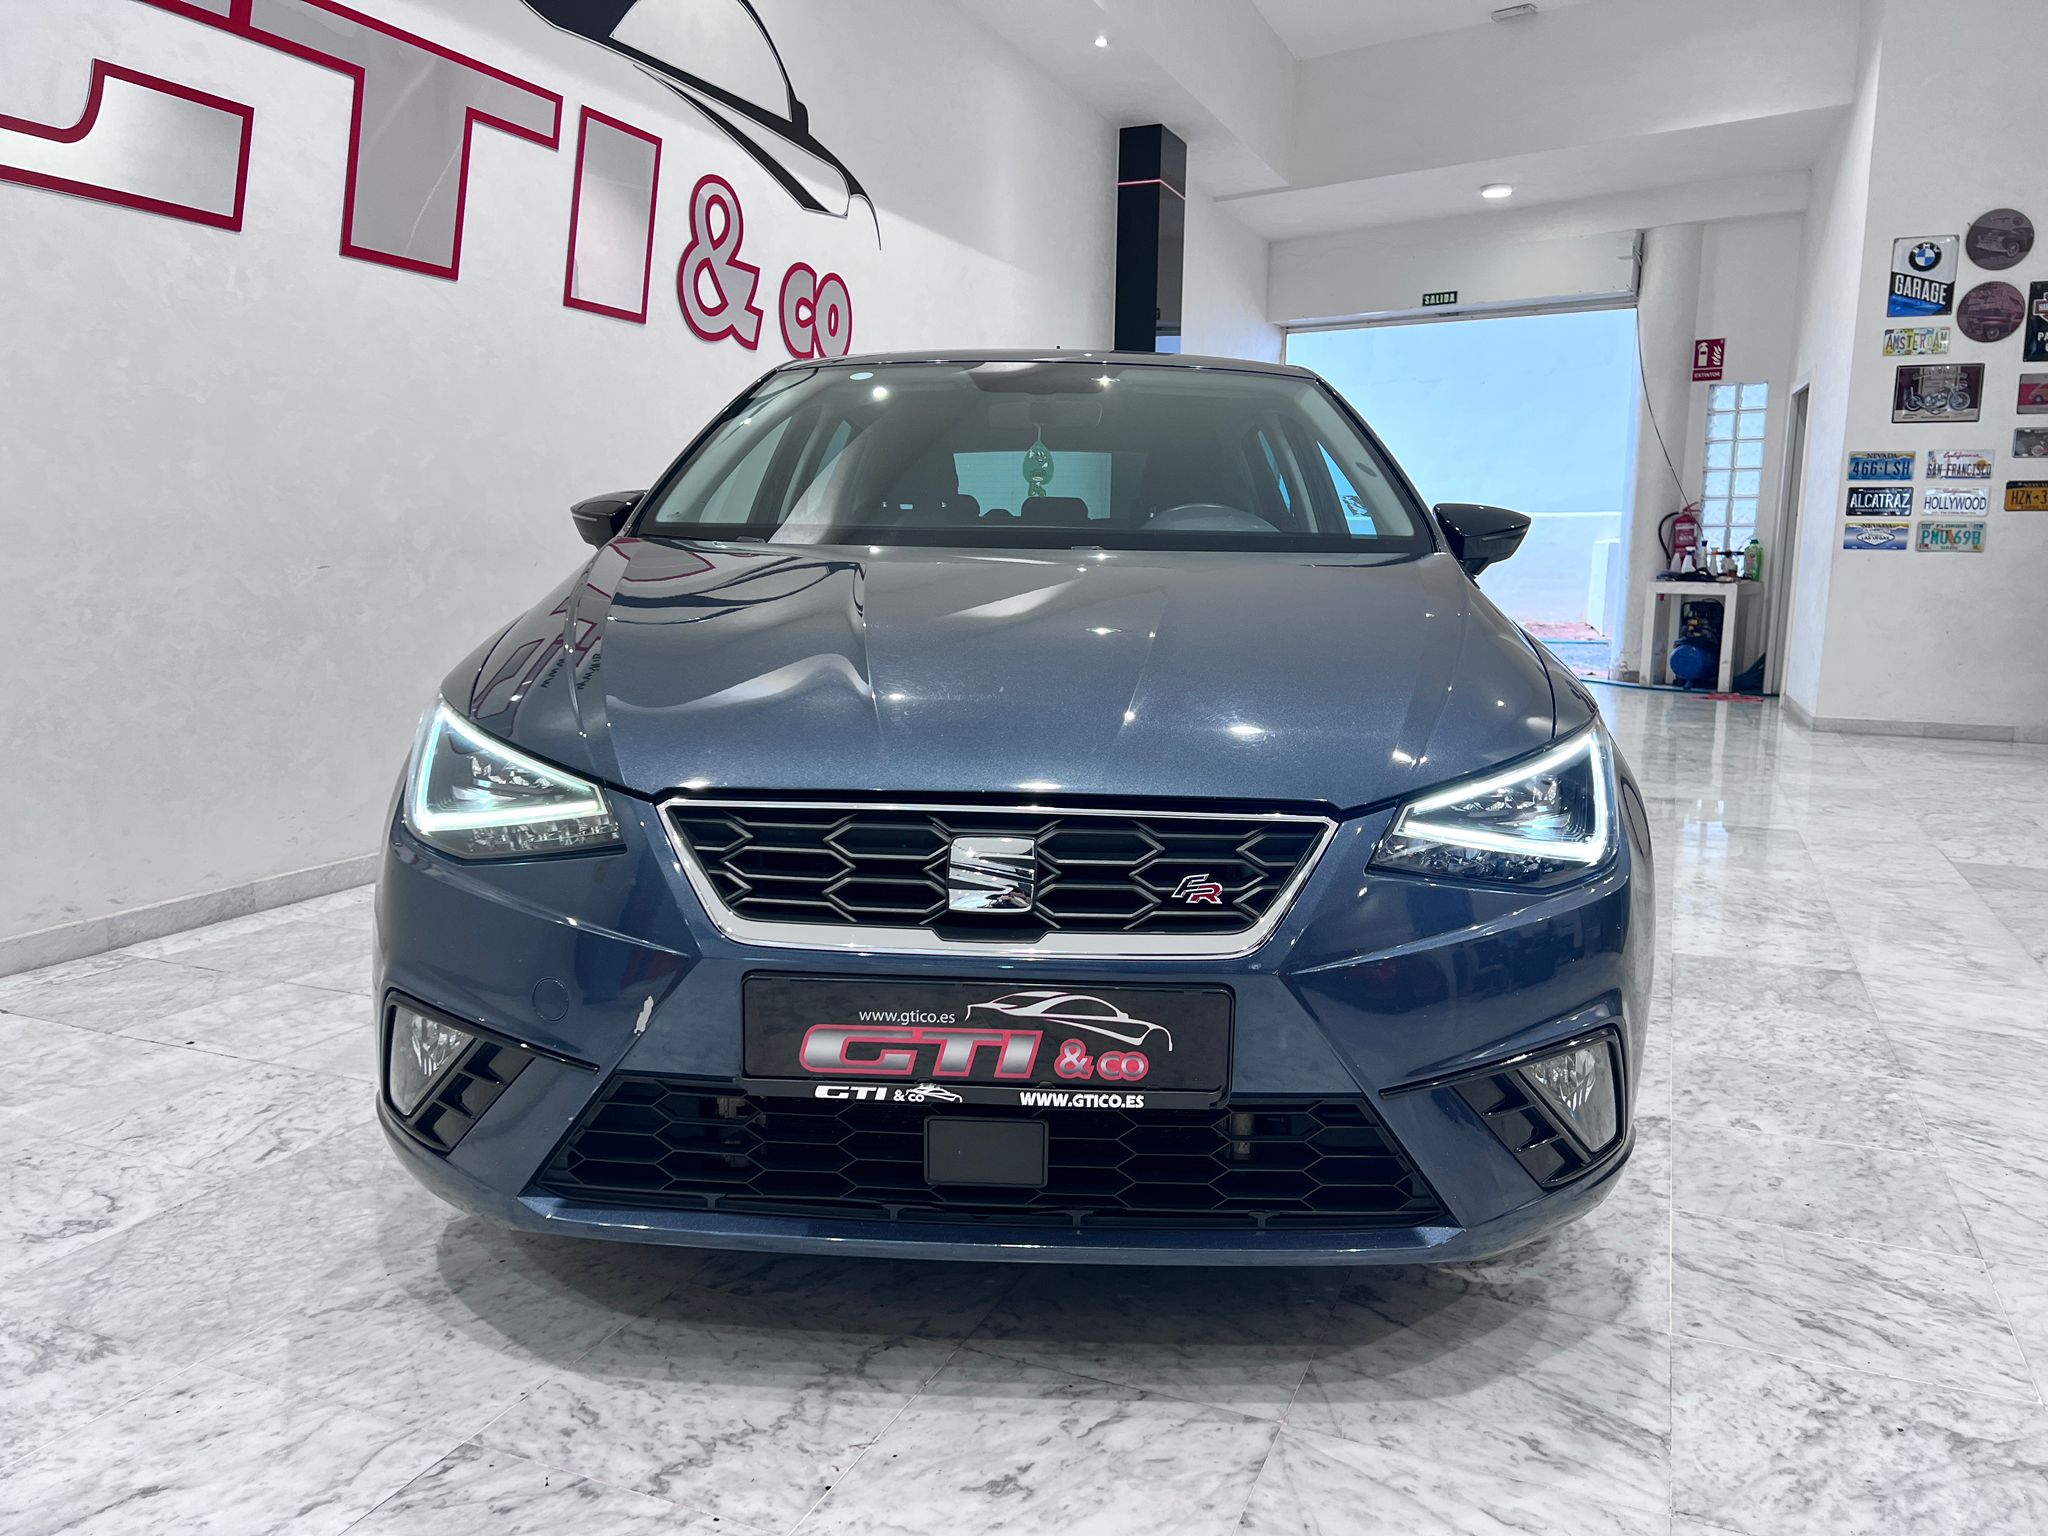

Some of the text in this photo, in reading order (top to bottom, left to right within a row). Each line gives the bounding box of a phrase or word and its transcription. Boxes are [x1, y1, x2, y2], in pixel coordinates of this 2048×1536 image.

[1894, 274, 1948, 305] GARAGE
[1424, 293, 1455, 305] SALIDA
[1886, 331, 1948, 351] AMSTERDAM
[1927, 463, 1992, 476] SAN FRANCISCO
[1850, 493, 1911, 508] ALCATRAZ
[1924, 496, 1987, 510] HOLLYWOOD
[858, 1008, 955, 1026] www.gtico.es
[800, 1023, 1043, 1079] GTI
[814, 1084, 888, 1101] GTI
[1020, 1091, 1145, 1109] WWW.GTICO.ES
